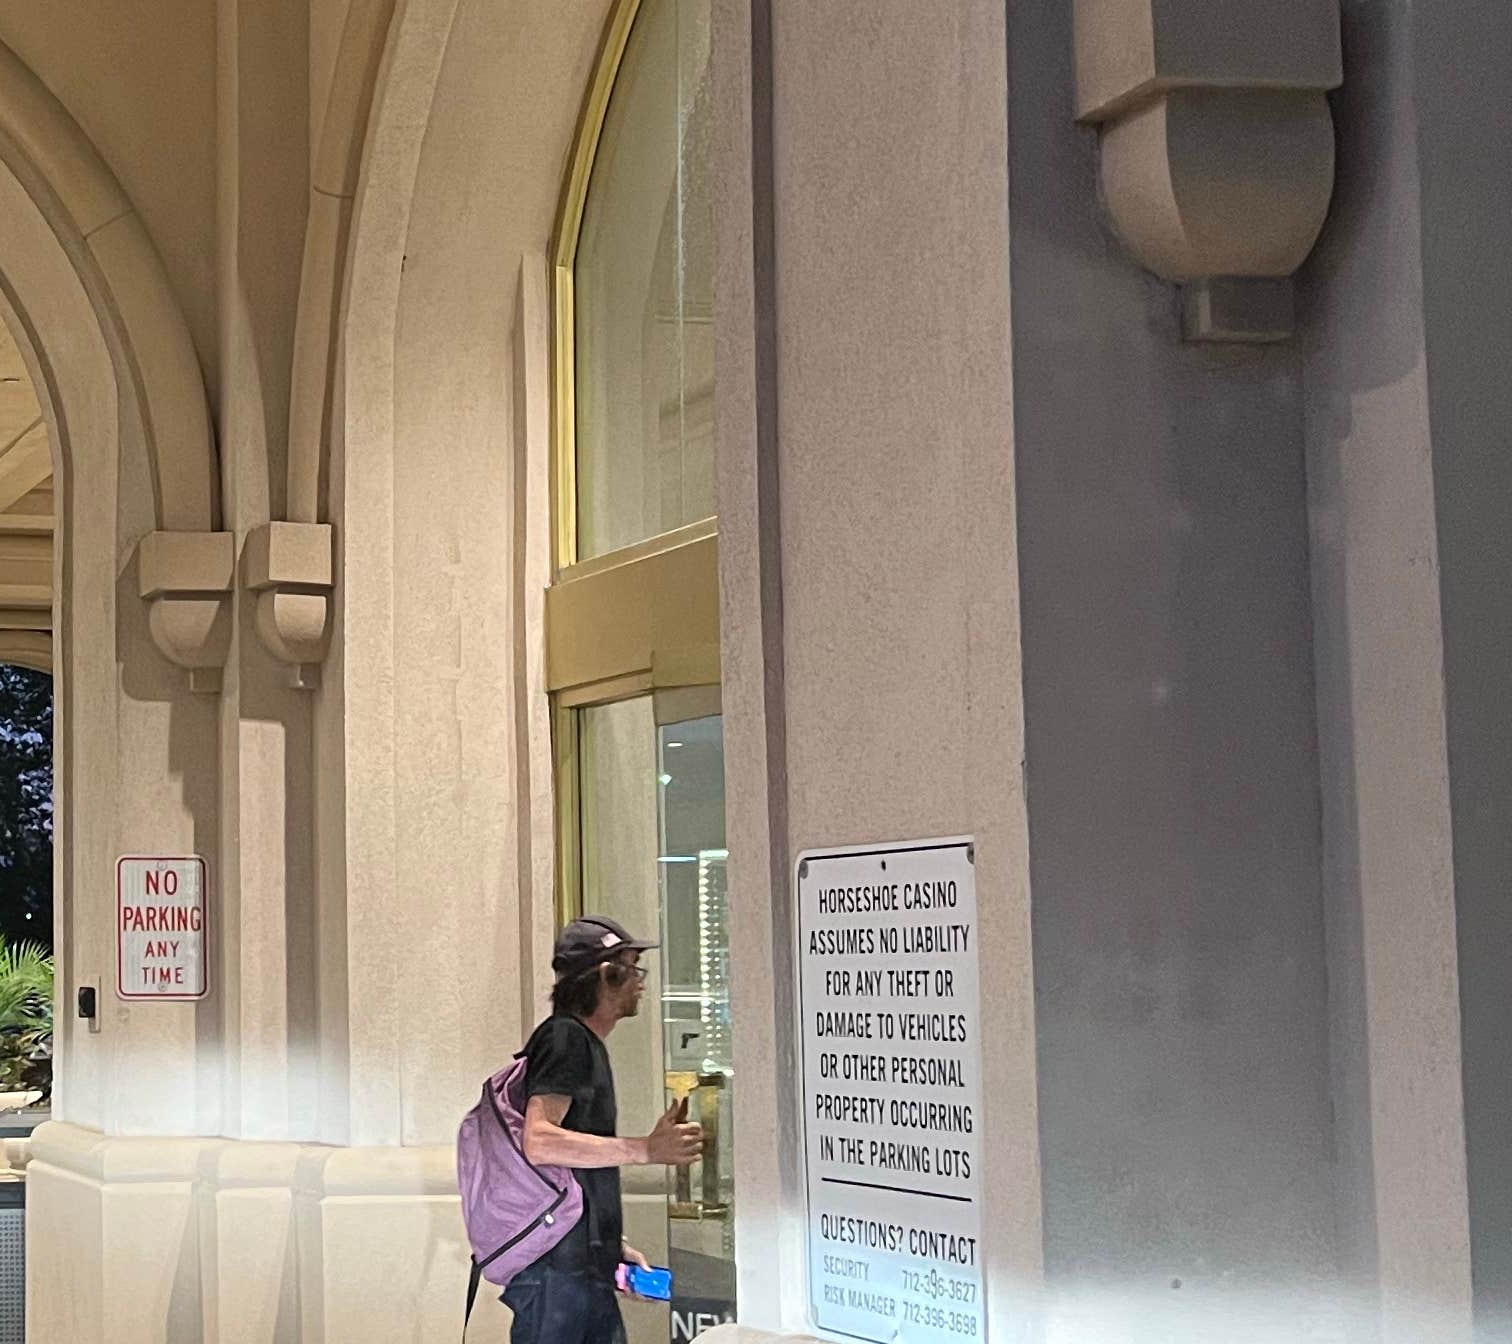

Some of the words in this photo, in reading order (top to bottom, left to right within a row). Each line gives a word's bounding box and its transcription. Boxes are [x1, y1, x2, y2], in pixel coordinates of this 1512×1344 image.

[145, 870, 178, 896] NO
[818, 884, 899, 914] HORSESHOE
[903, 880, 957, 910] CASINO
[122, 906, 202, 932] PARKING
[144, 941, 180, 959] ANY
[809, 928, 875, 955] ASSUMES
[879, 927, 898, 954] NO
[903, 924, 970, 954] LIABILITY
[142, 966, 184, 984] TIME
[825, 970, 851, 997] FOR
[855, 970, 883, 997] ANY
[887, 970, 930, 997] THEFT
[935, 969, 954, 998] OR
[816, 1012, 873, 1039] DAMAGE
[877, 1013, 894, 1040] TO
[899, 1013, 967, 1043] VEHICLES
[820, 1053, 838, 1079] OR
[843, 1054, 887, 1082] OTHER
[892, 1056, 966, 1088] PERSONAL
[816, 1094, 885, 1125] PROPERTY
[891, 1099, 973, 1134] OCCURRING
[820, 1134, 834, 1161] IN
[838, 1137, 865, 1166] THE
[870, 1141, 931, 1174] PARKING
[936, 1147, 971, 1180] LOTS
[820, 1213, 904, 1253] QUESTIONS?
[909, 1228, 976, 1266] CONTACT
[823, 1255, 870, 1282] SECURITY
[824, 1284, 845, 1306] RISK
[848, 1290, 896, 1318] MANAGER
